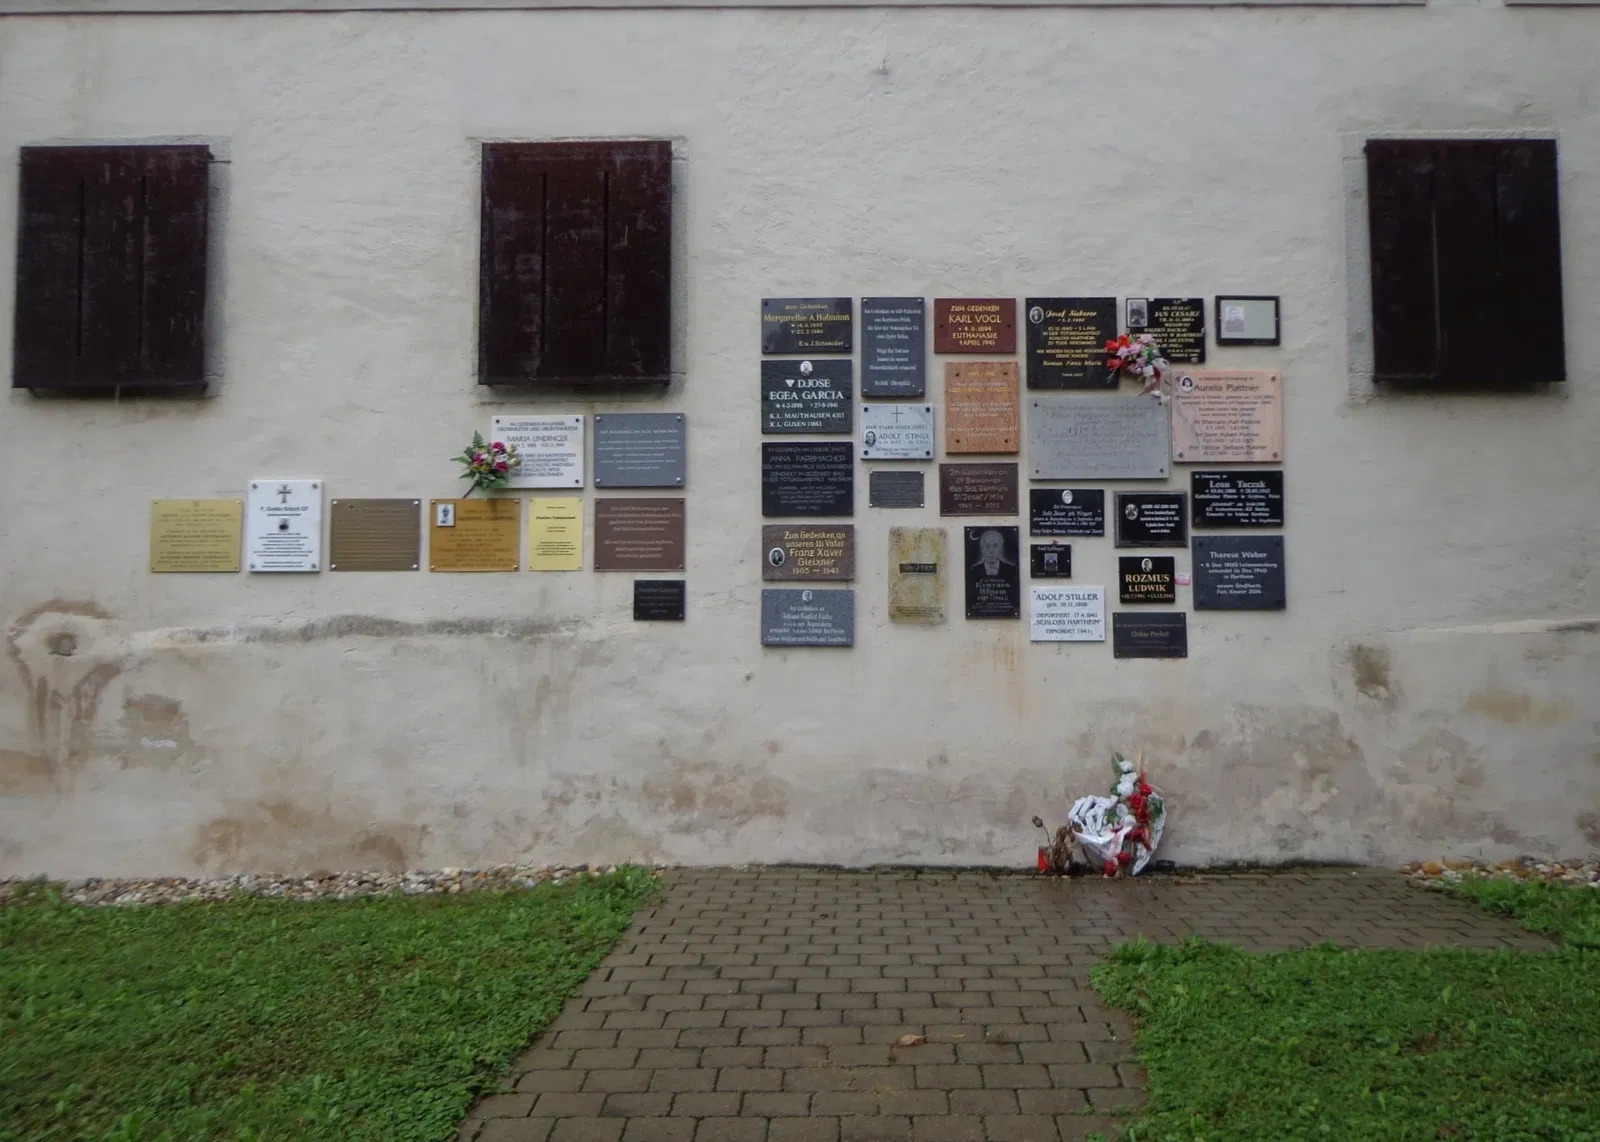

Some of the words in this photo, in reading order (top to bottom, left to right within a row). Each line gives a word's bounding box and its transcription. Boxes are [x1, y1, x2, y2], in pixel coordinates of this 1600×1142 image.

[948, 314, 973, 324] KARL
[974, 314, 1002, 324] VOGL
[1194, 383, 1223, 392] Aurelia
[1226, 383, 1261, 392] Plattner
[769, 390, 799, 400] EGEA
[802, 390, 844, 400] GARCIA
[1209, 480, 1231, 488] Leon
[784, 531, 799, 540] Zum
[785, 540, 814, 548] unseren
[825, 539, 845, 548] Vater
[789, 548, 815, 557] Franz
[817, 548, 843, 557] Xaver
[1209, 551, 1239, 559] Therese
[1241, 551, 1268, 559] Weber
[797, 557, 835, 567] Gleixner
[792, 567, 810, 575] 1905
[823, 567, 839, 575] 1941
[1125, 574, 1170, 583] ROZMUS
[1128, 584, 1167, 592] LUDWIK
[1035, 593, 1064, 601] ADOLF
[1065, 593, 1099, 601] STILLER
